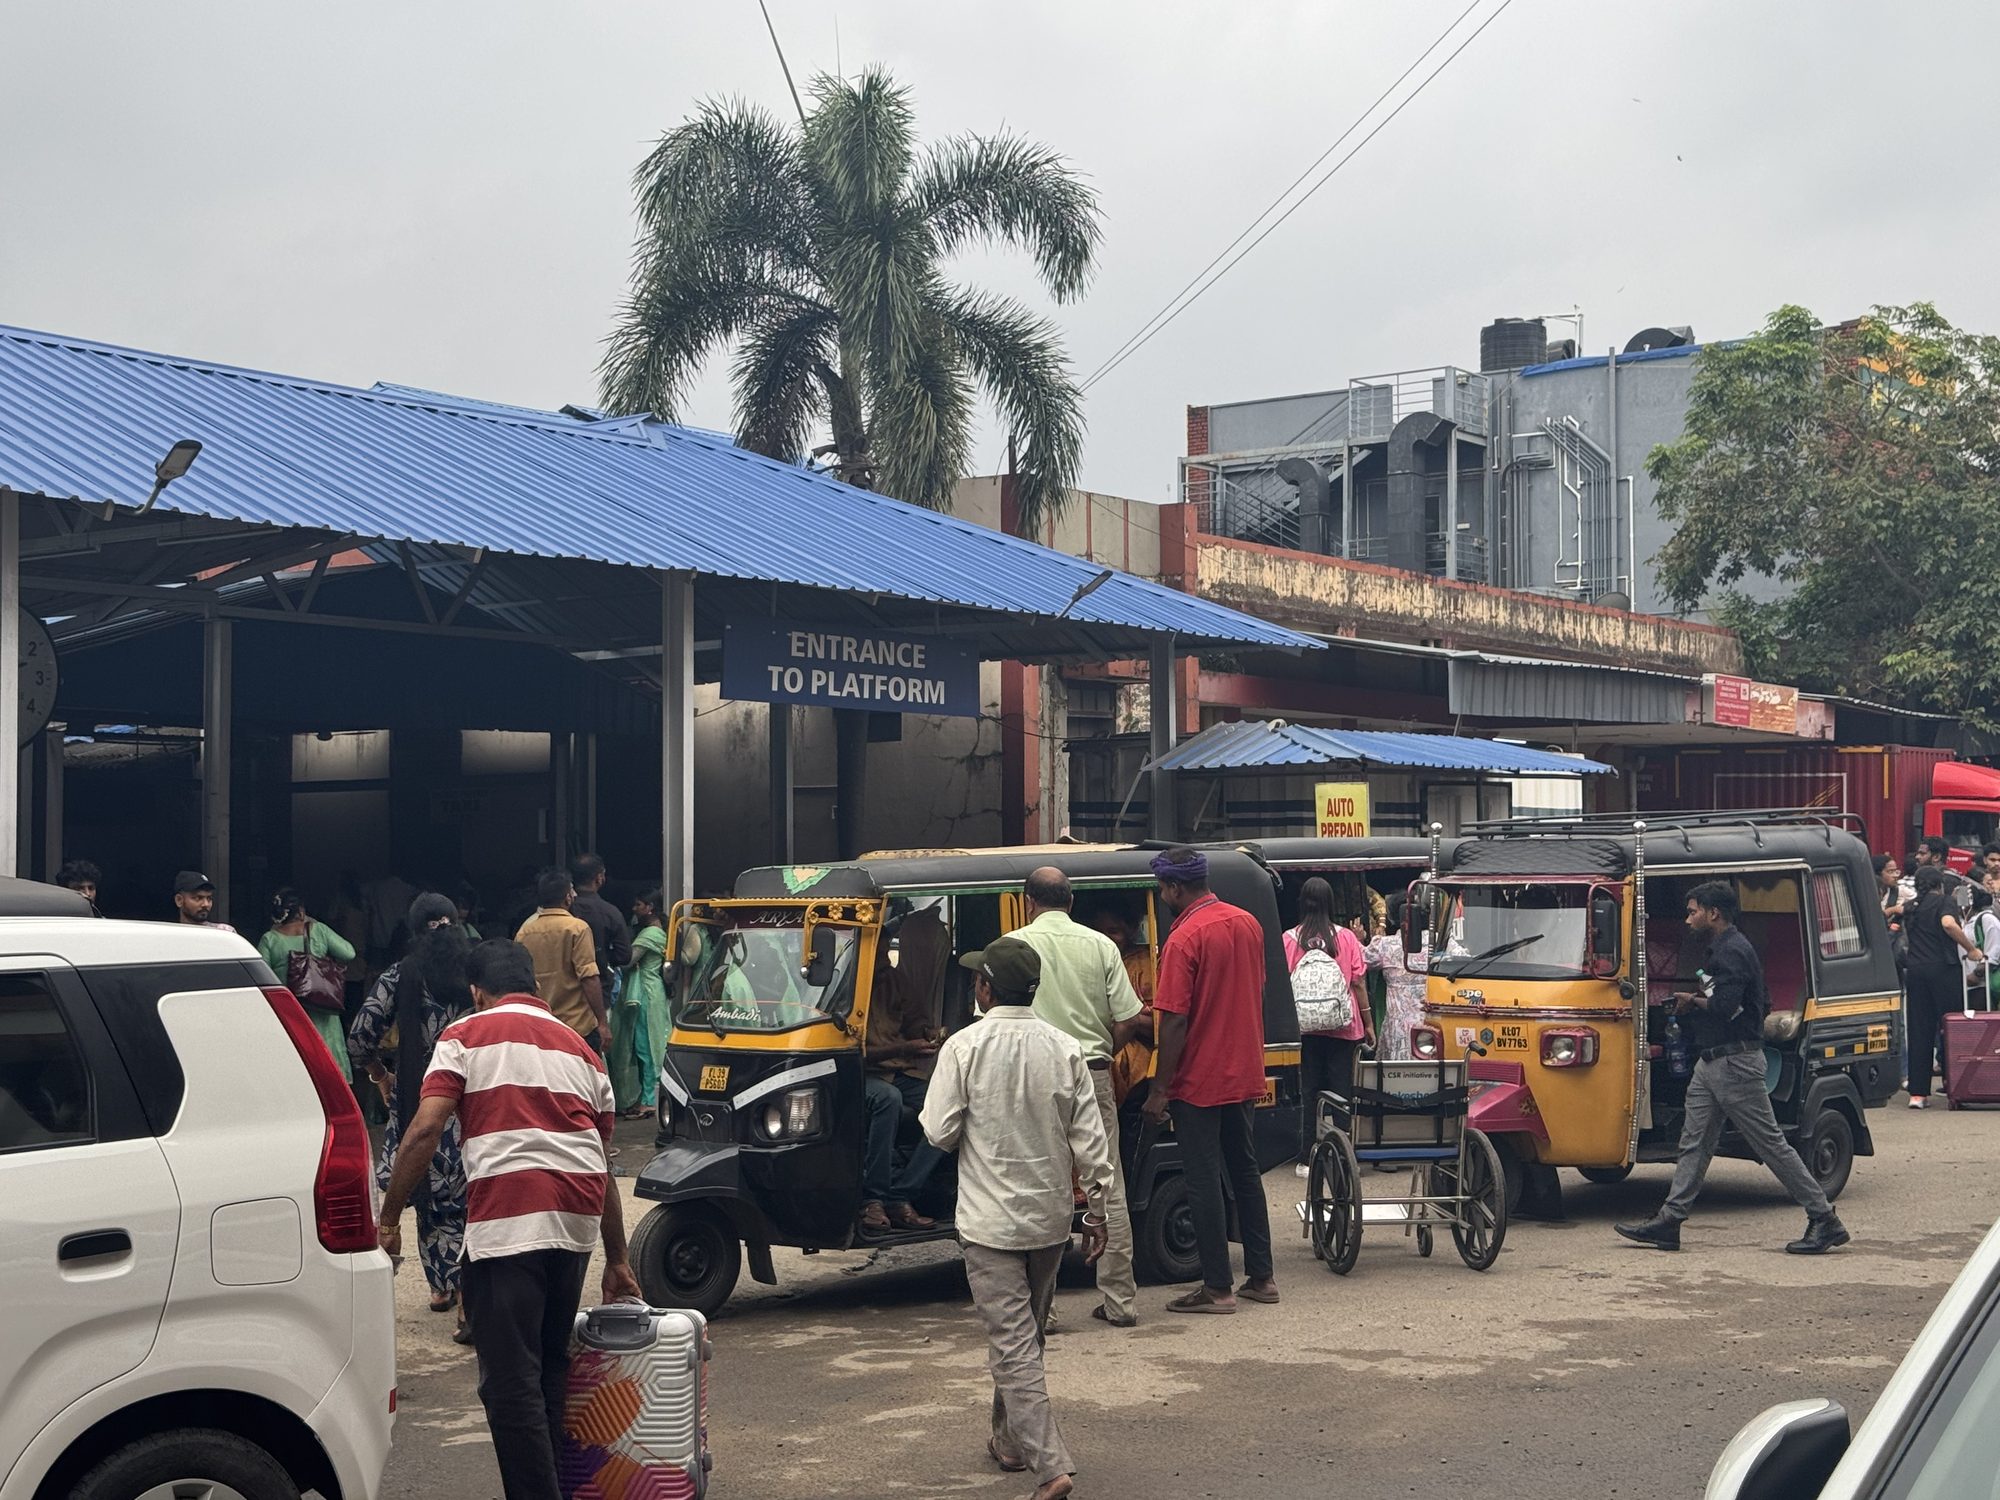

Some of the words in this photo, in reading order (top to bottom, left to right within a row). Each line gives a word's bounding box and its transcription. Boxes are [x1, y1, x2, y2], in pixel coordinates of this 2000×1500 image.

[28, 641, 37, 656] 2
[790, 631, 926, 669] ENTRANCE
[35, 670, 44, 685] 3
[768, 665, 804, 693] TO
[811, 669, 945, 705] PLATFORM
[27, 698, 35, 713] 4
[1327, 798, 1354, 817] AUTO
[1321, 822, 1364, 838] PREPAID
[749, 909, 805, 927] ARYA
[708, 1006, 760, 1021] Ambadi
[1501, 1026, 1521, 1036] KL07
[1387, 1071, 1401, 1079] CSR
[1402, 1071, 1432, 1079] initiative
